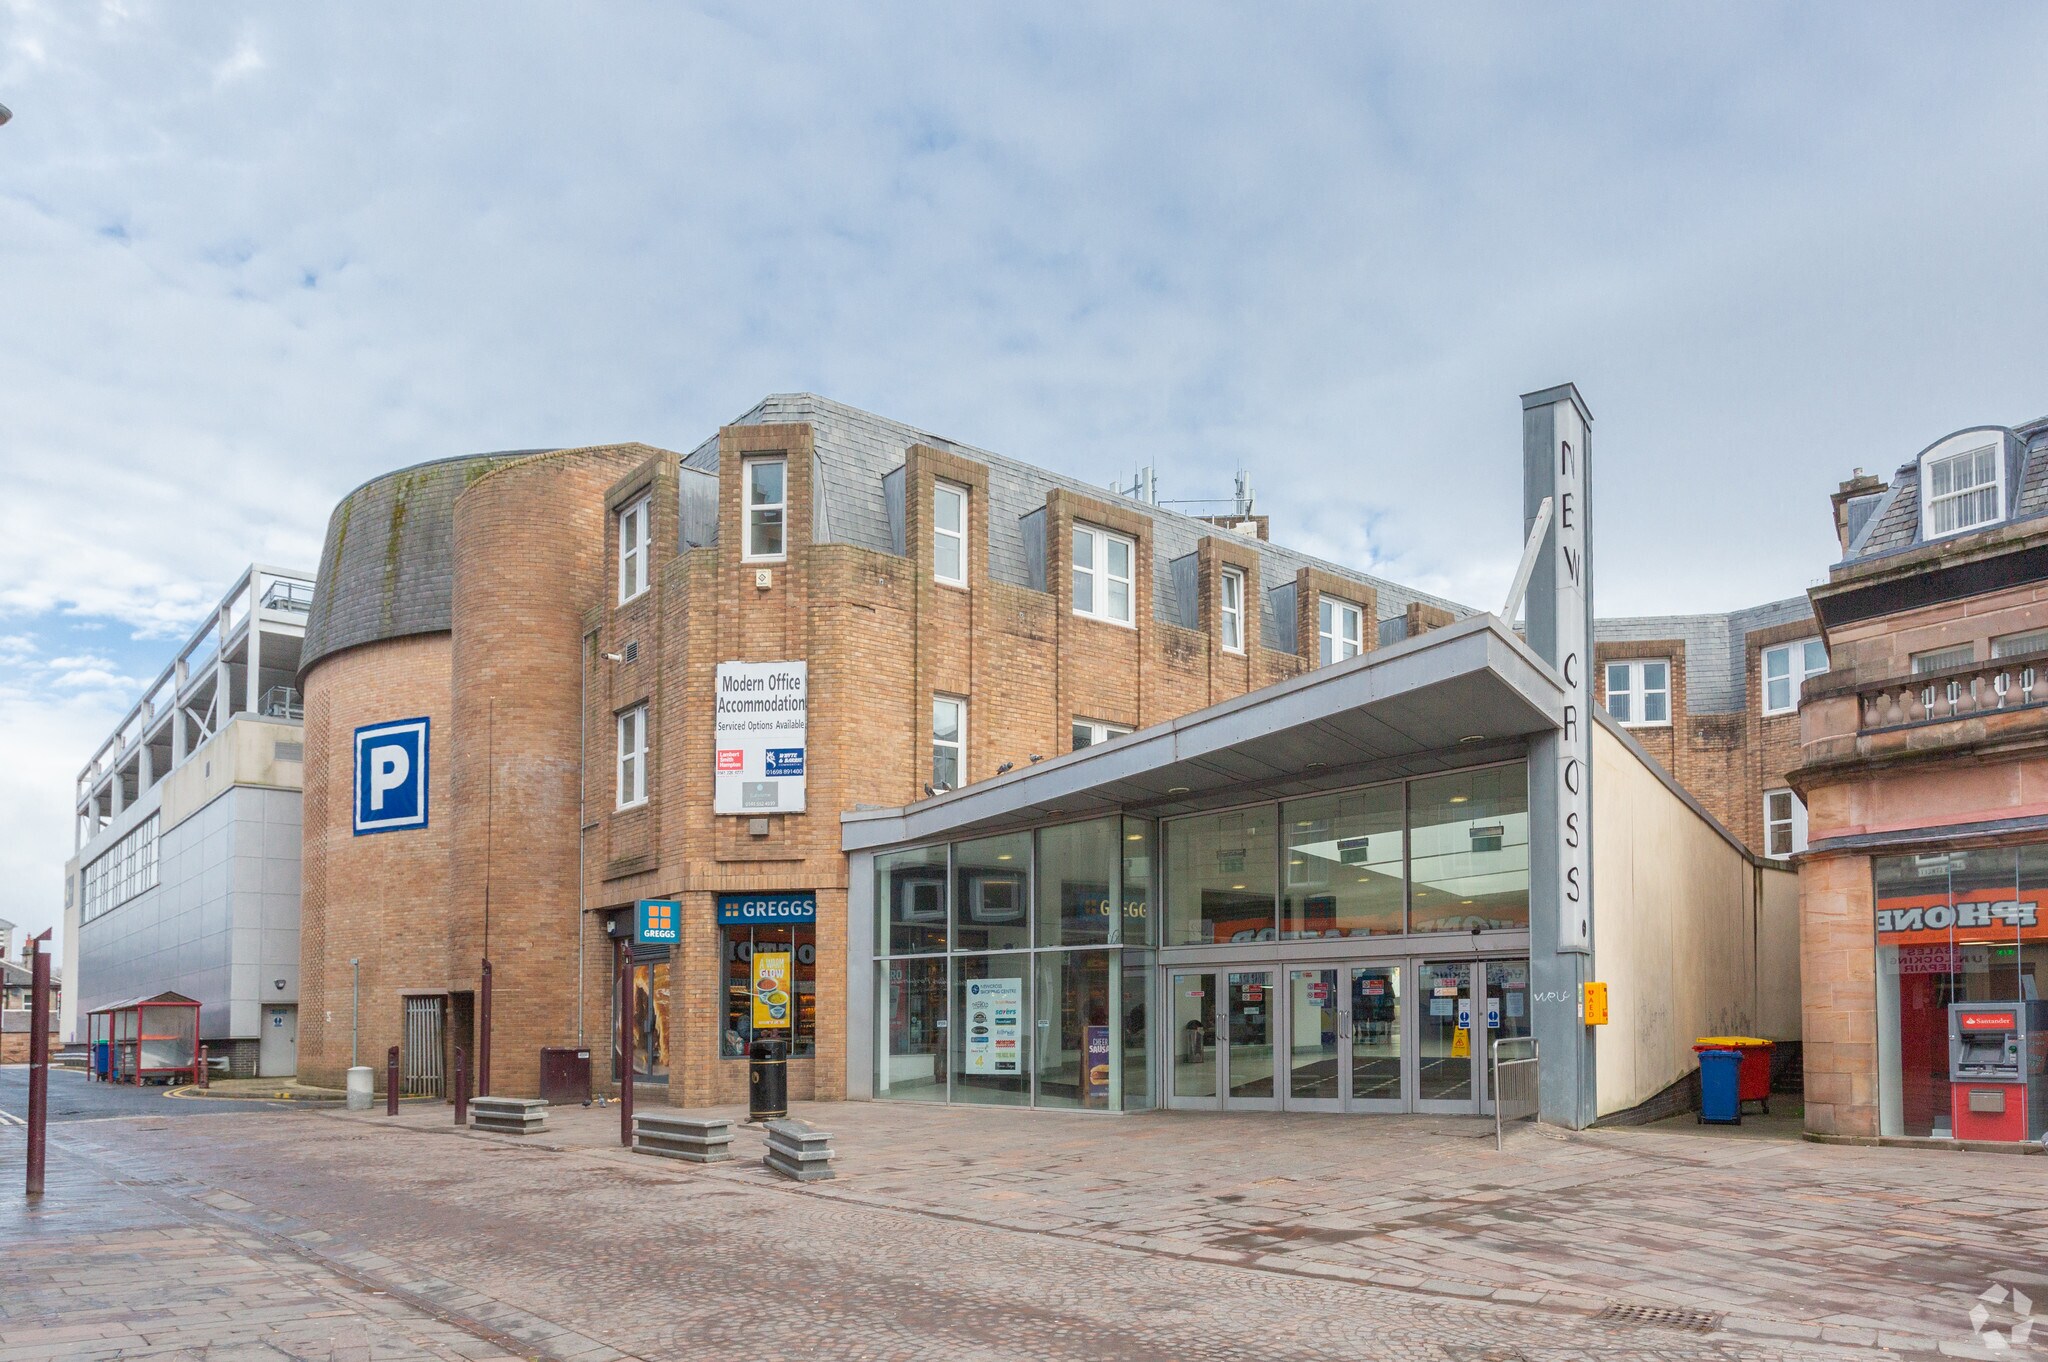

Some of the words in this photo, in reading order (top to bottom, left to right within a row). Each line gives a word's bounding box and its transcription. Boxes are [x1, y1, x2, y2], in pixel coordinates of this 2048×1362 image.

[1561, 440, 1581, 587] NEW
[722, 674, 764, 692] Modern
[768, 672, 801, 691] Office
[718, 694, 805, 713] Accommodation
[717, 721, 746, 732] Serviced
[747, 720, 774, 732] Options
[775, 719, 805, 730] Available
[370, 744, 410, 811] P
[1563, 652, 1580, 903] CROSS
[742, 900, 814, 917] GREGGS
[643, 929, 676, 938] GREGGS
[760, 968, 784, 979] GLOW
[1088, 1044, 1110, 1054] SAUSA
